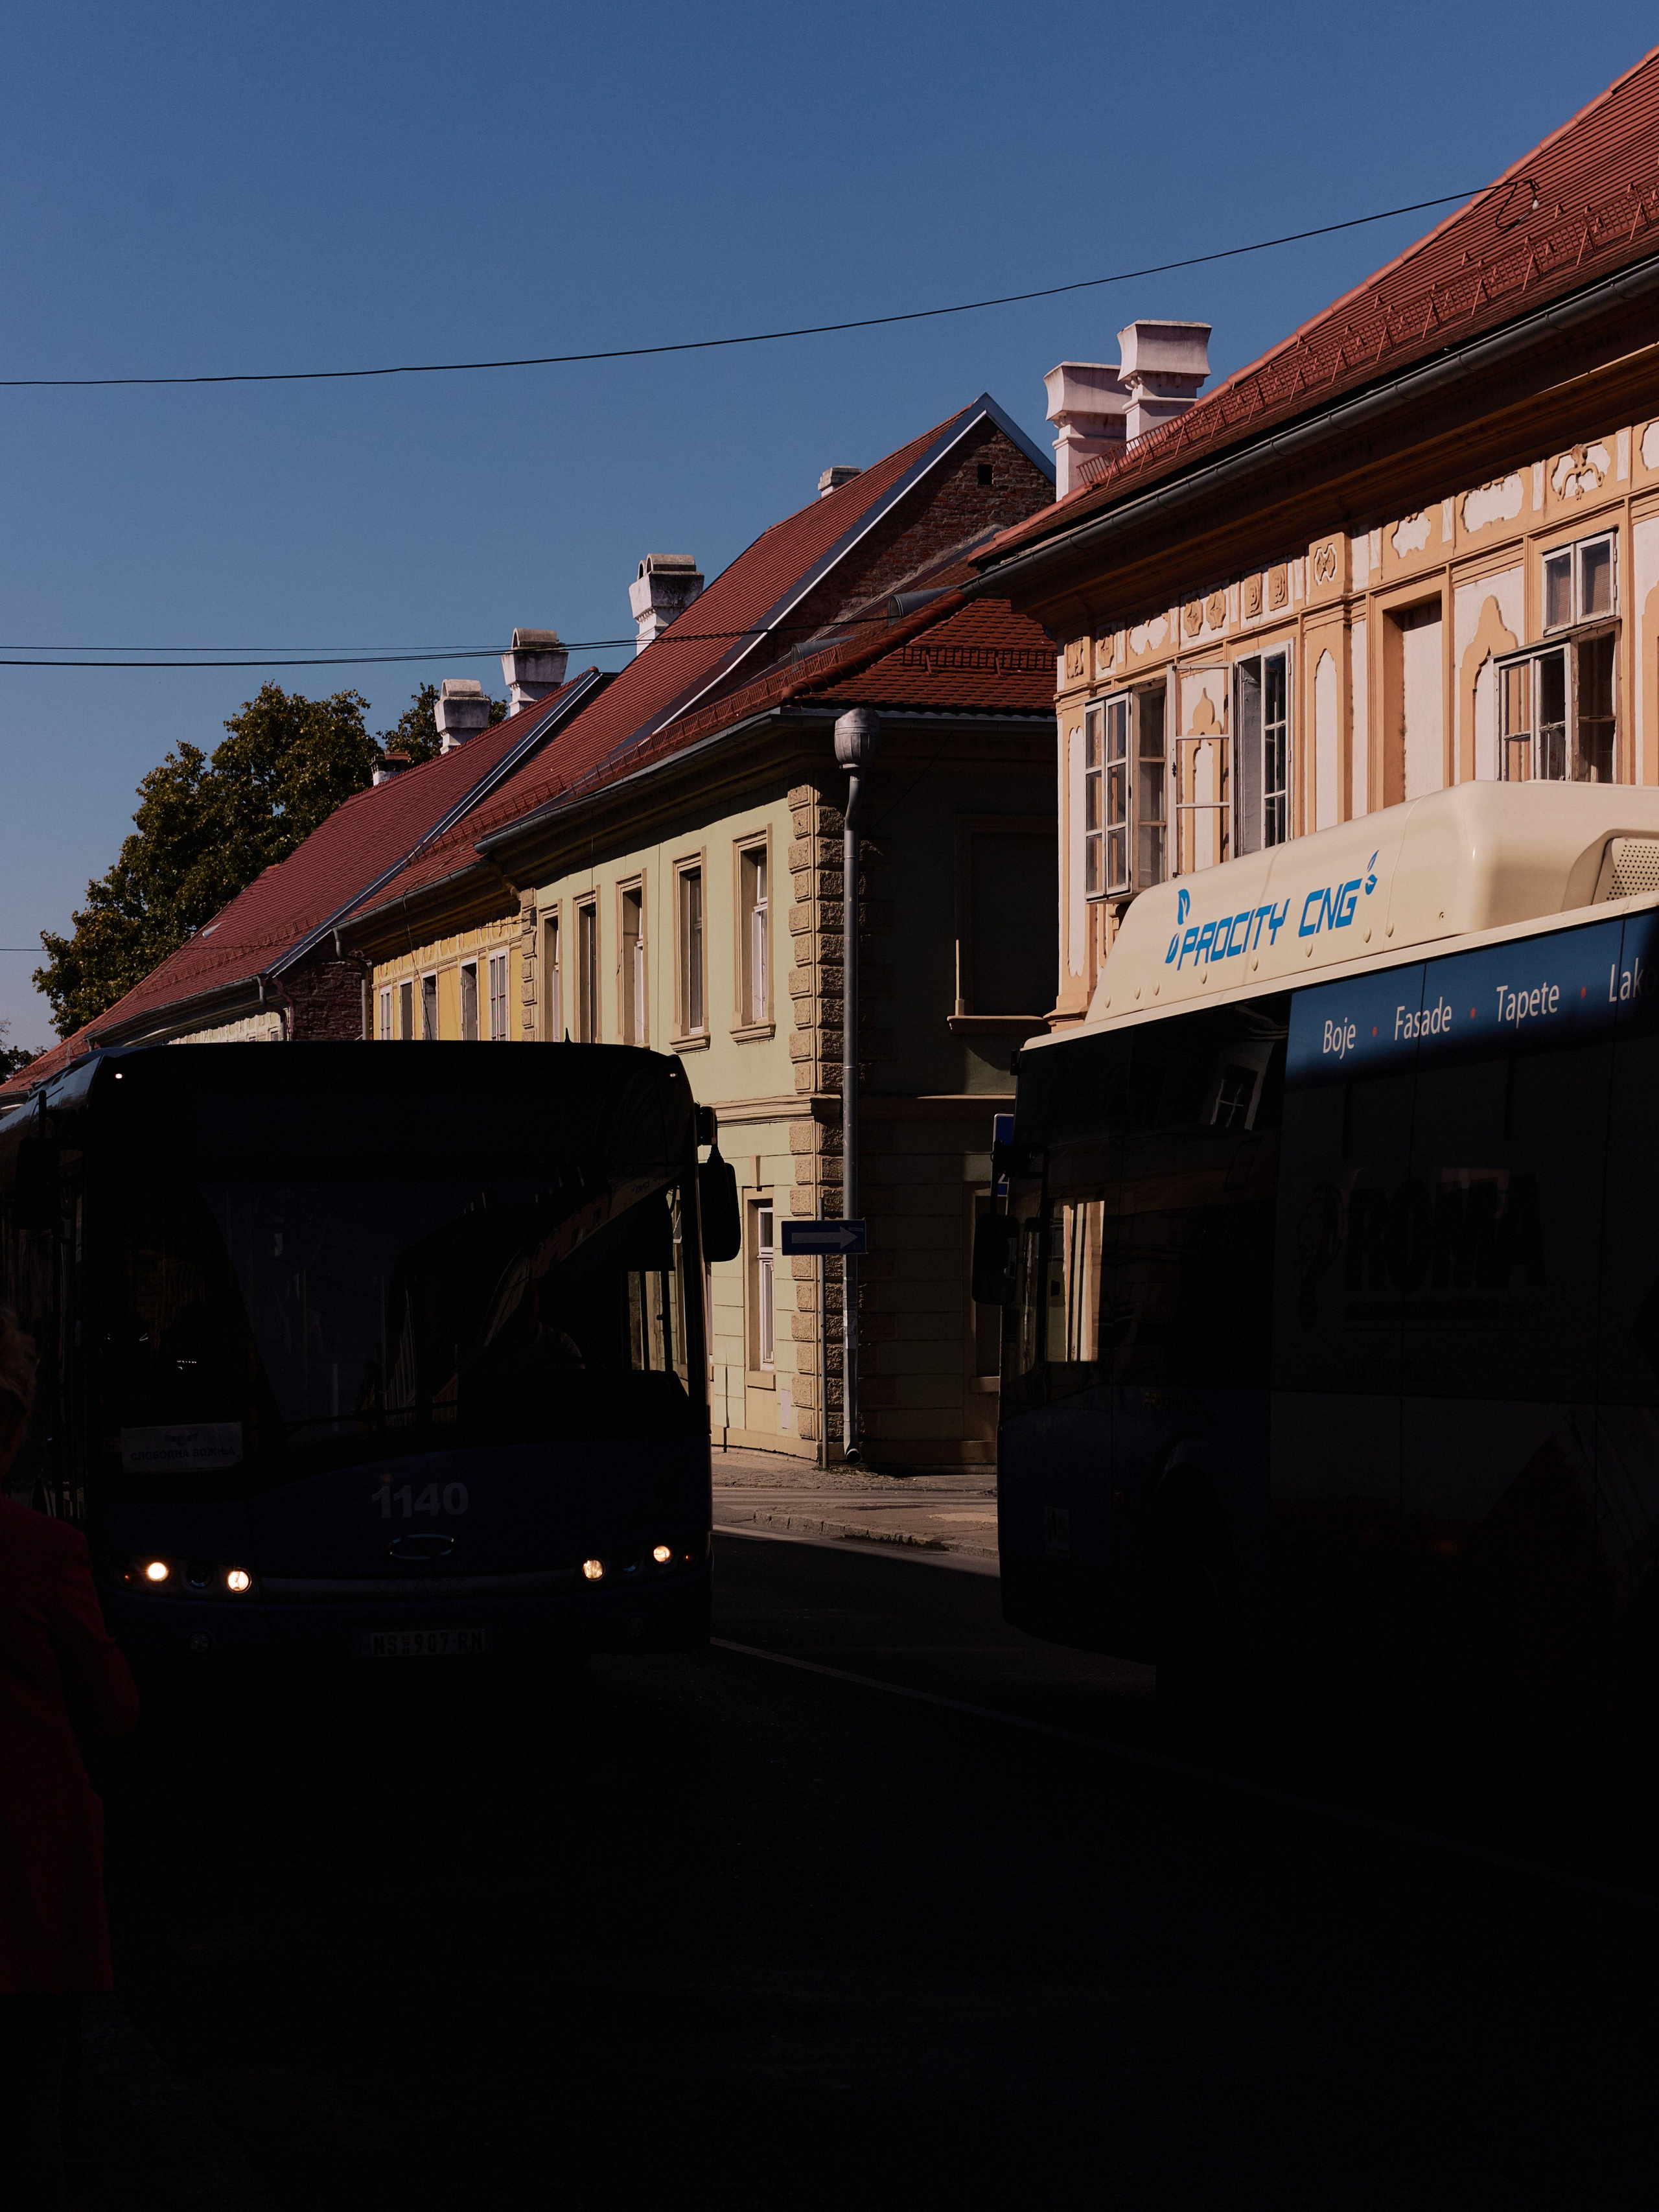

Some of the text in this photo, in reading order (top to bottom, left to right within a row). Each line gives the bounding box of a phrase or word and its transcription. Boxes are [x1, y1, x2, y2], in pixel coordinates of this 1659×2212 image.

[1176, 878, 1363, 971] PROCITY CNG
[1323, 1017, 1356, 1060] Boje
[1394, 996, 1453, 1042] Fasade
[1496, 981, 1560, 1029] Tapete
[1345, 1174, 1548, 1294] ROMA
[130, 1446, 236, 1461] СЛОБОДНА ВОЖЊА
[371, 1482, 469, 1519] 1140
[373, 1633, 398, 1655] NS
